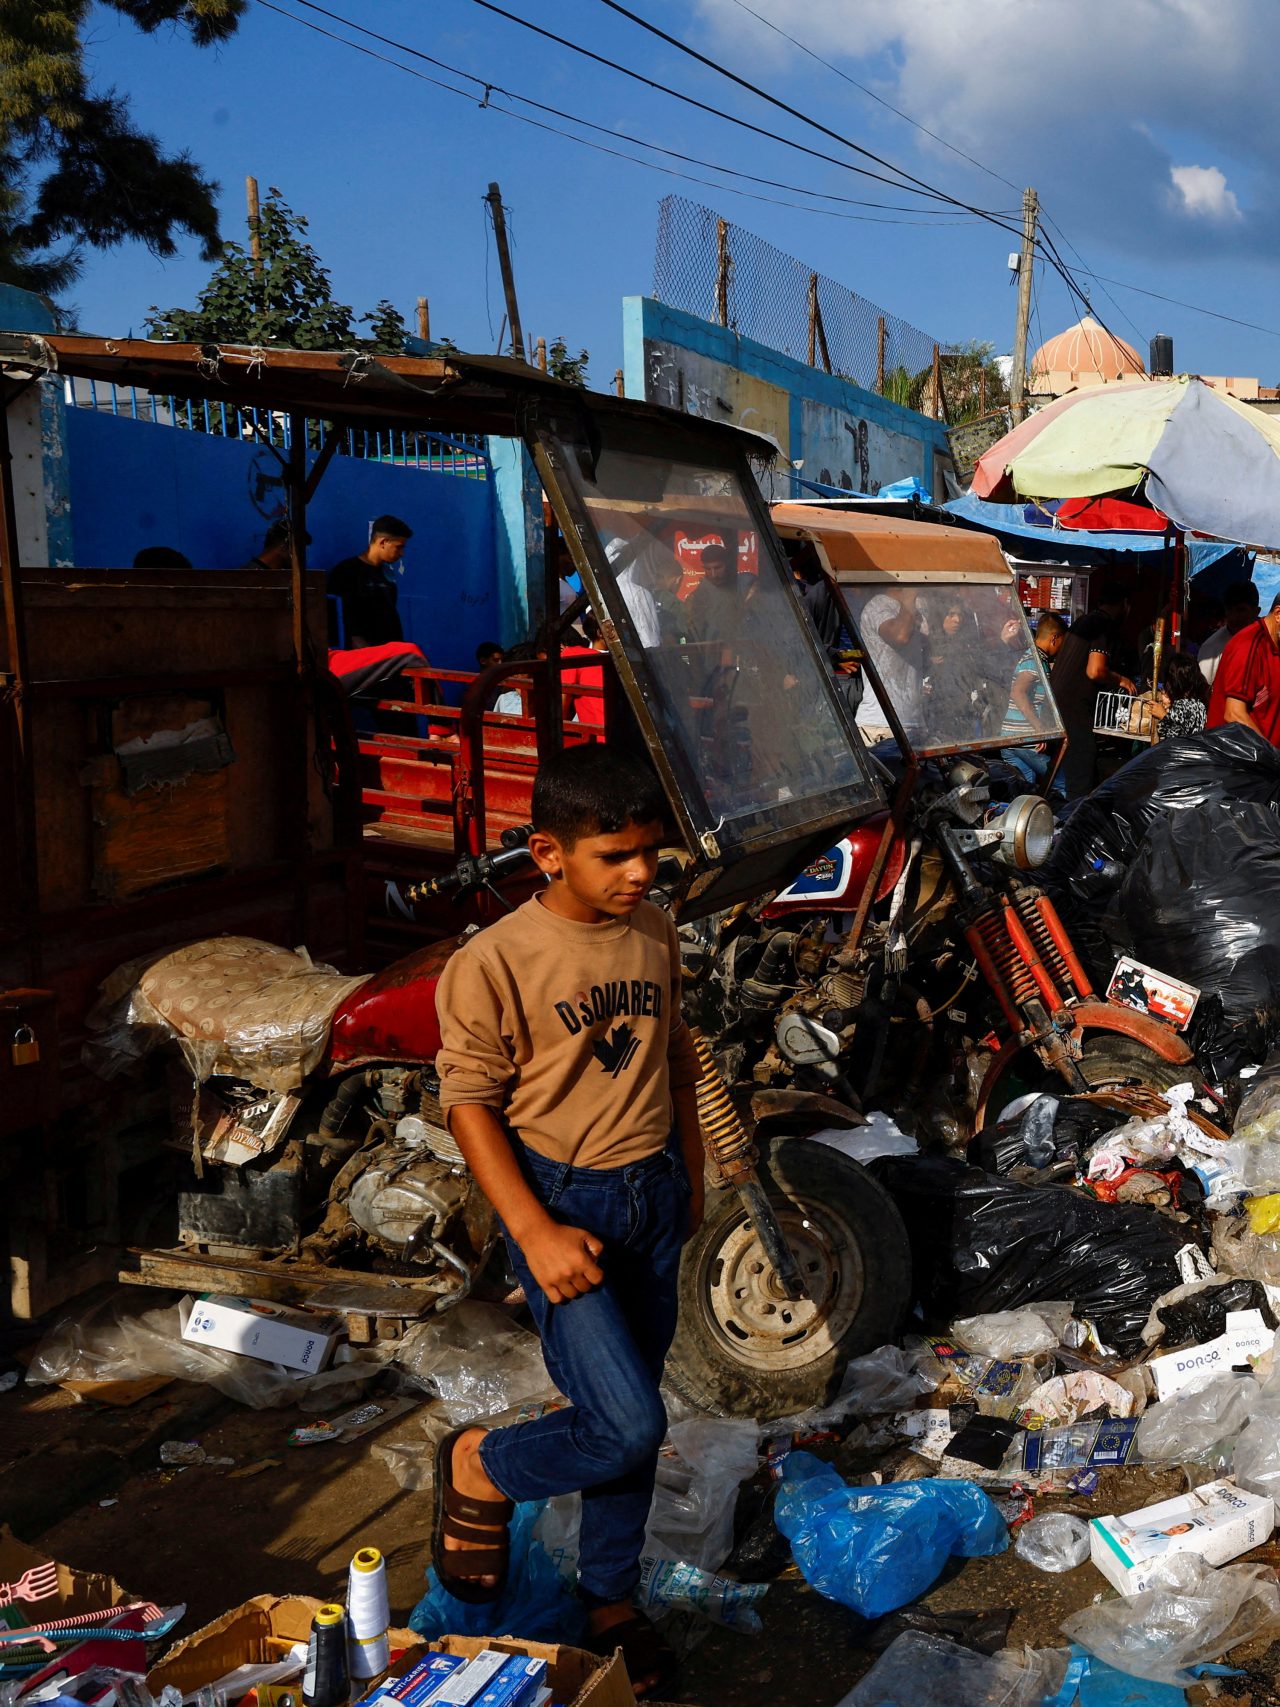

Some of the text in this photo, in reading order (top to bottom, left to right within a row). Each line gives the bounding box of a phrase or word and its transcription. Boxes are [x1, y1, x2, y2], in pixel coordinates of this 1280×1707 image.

[302, 1340, 315, 1363] DORCO
[1235, 1339, 1260, 1348] DORCO
[1176, 1350, 1220, 1372] DORCO
[1216, 1488, 1247, 1509] DORCO
[390, 1662, 427, 1696] ANTI-CARIES
